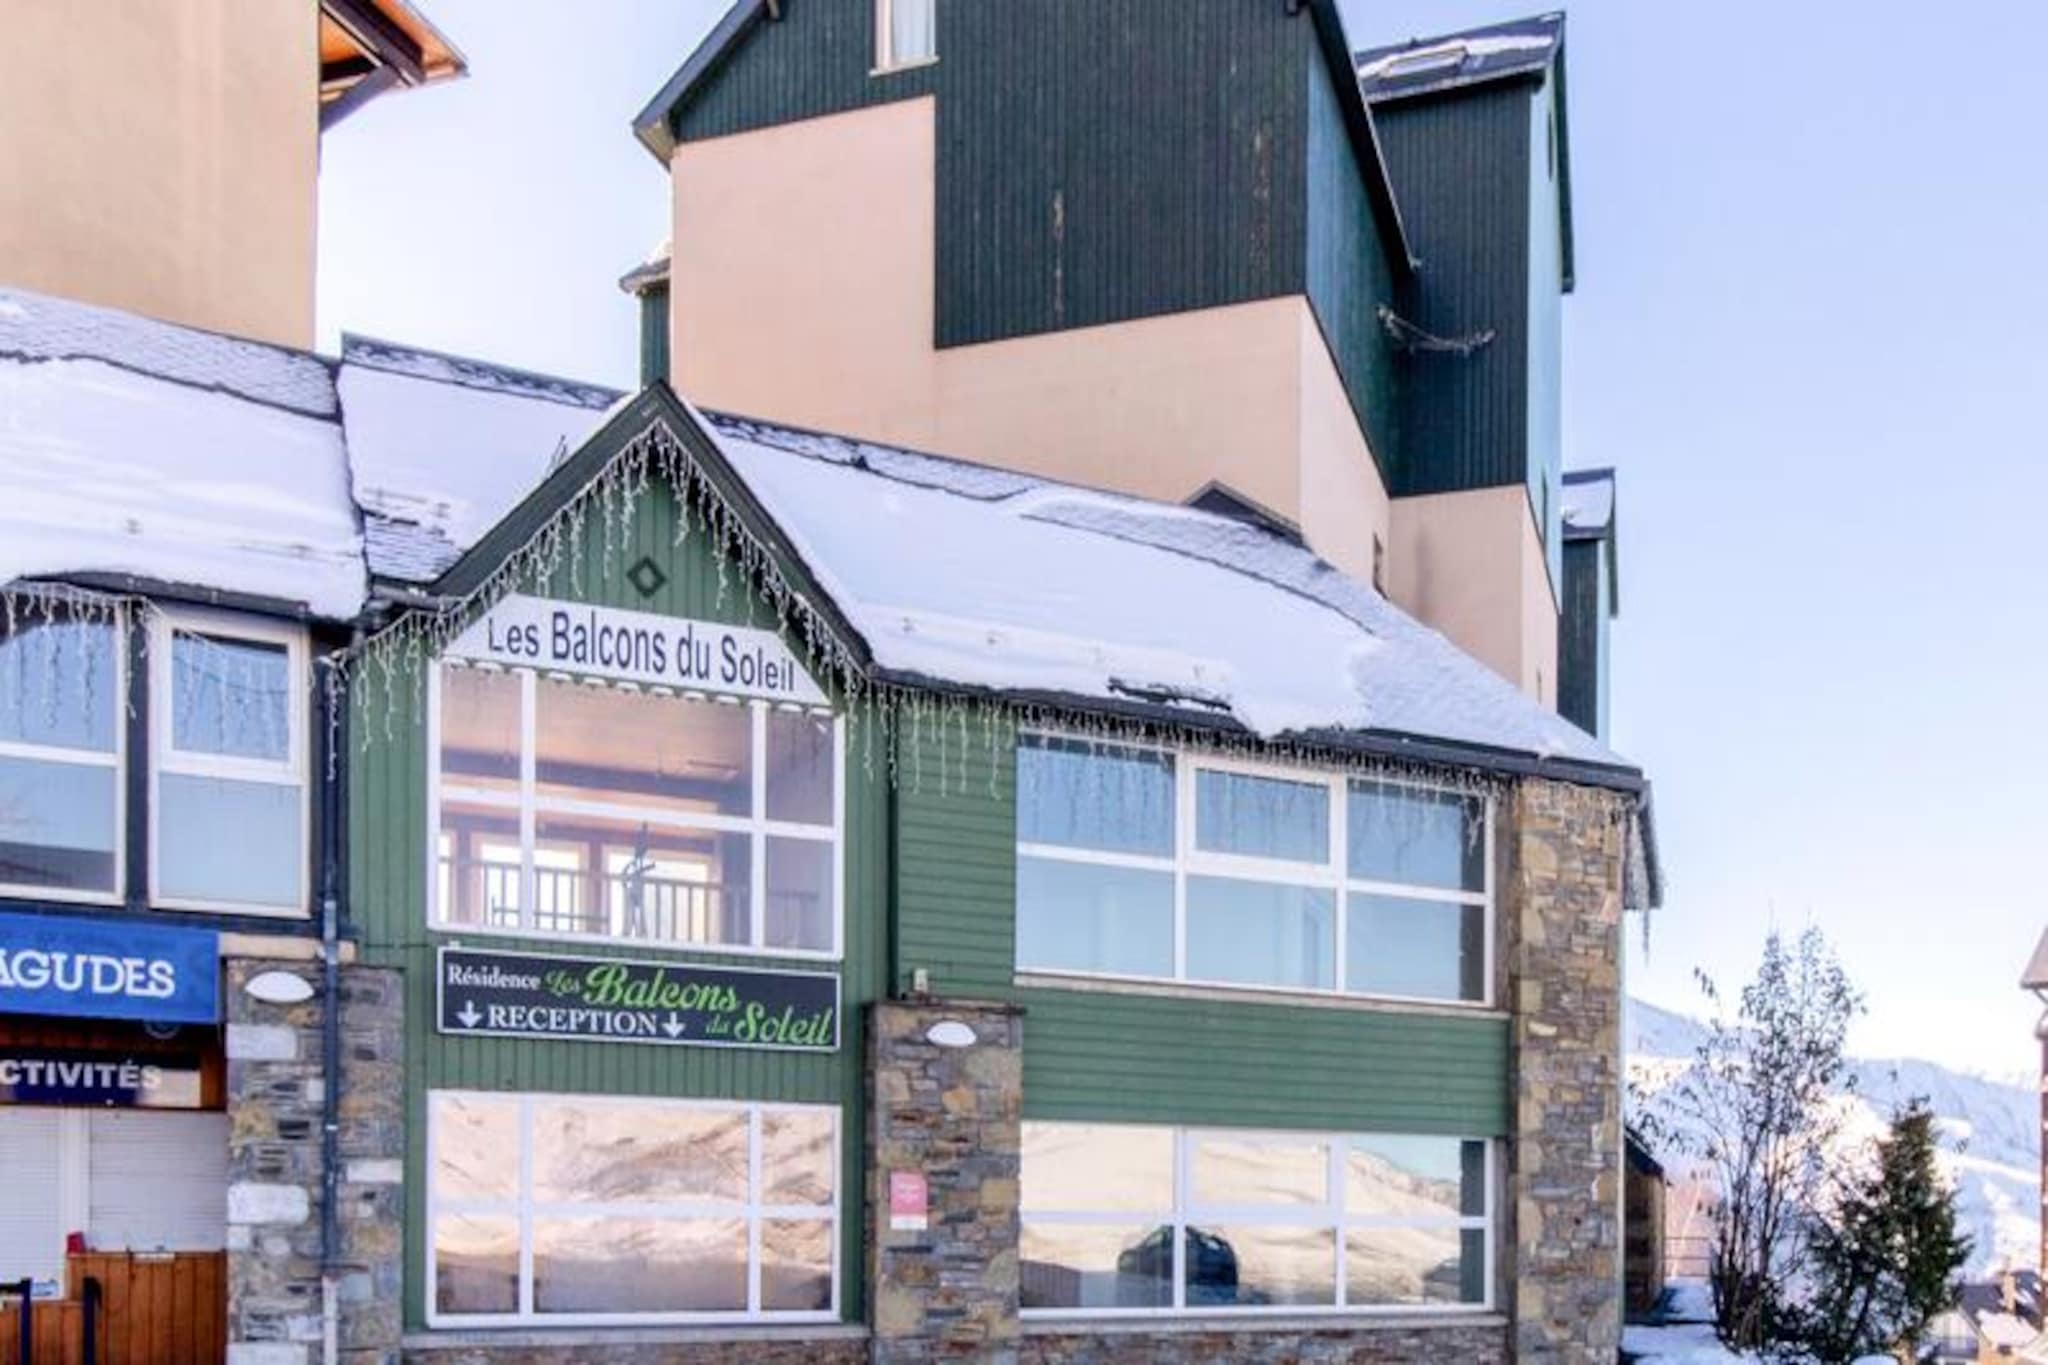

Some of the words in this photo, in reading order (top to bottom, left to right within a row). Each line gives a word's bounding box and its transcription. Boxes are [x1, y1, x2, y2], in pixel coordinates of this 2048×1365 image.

[487, 617, 539, 657] Les
[551, 611, 667, 677] Balcons
[677, 623, 711, 679] du
[721, 634, 794, 692] Soleil
[447, 963, 540, 990] Résidence
[488, 1006, 659, 1036] RECEPTION
[734, 1002, 833, 1045] Soleil
[0, 1058, 161, 1090] CTIVITÉS
